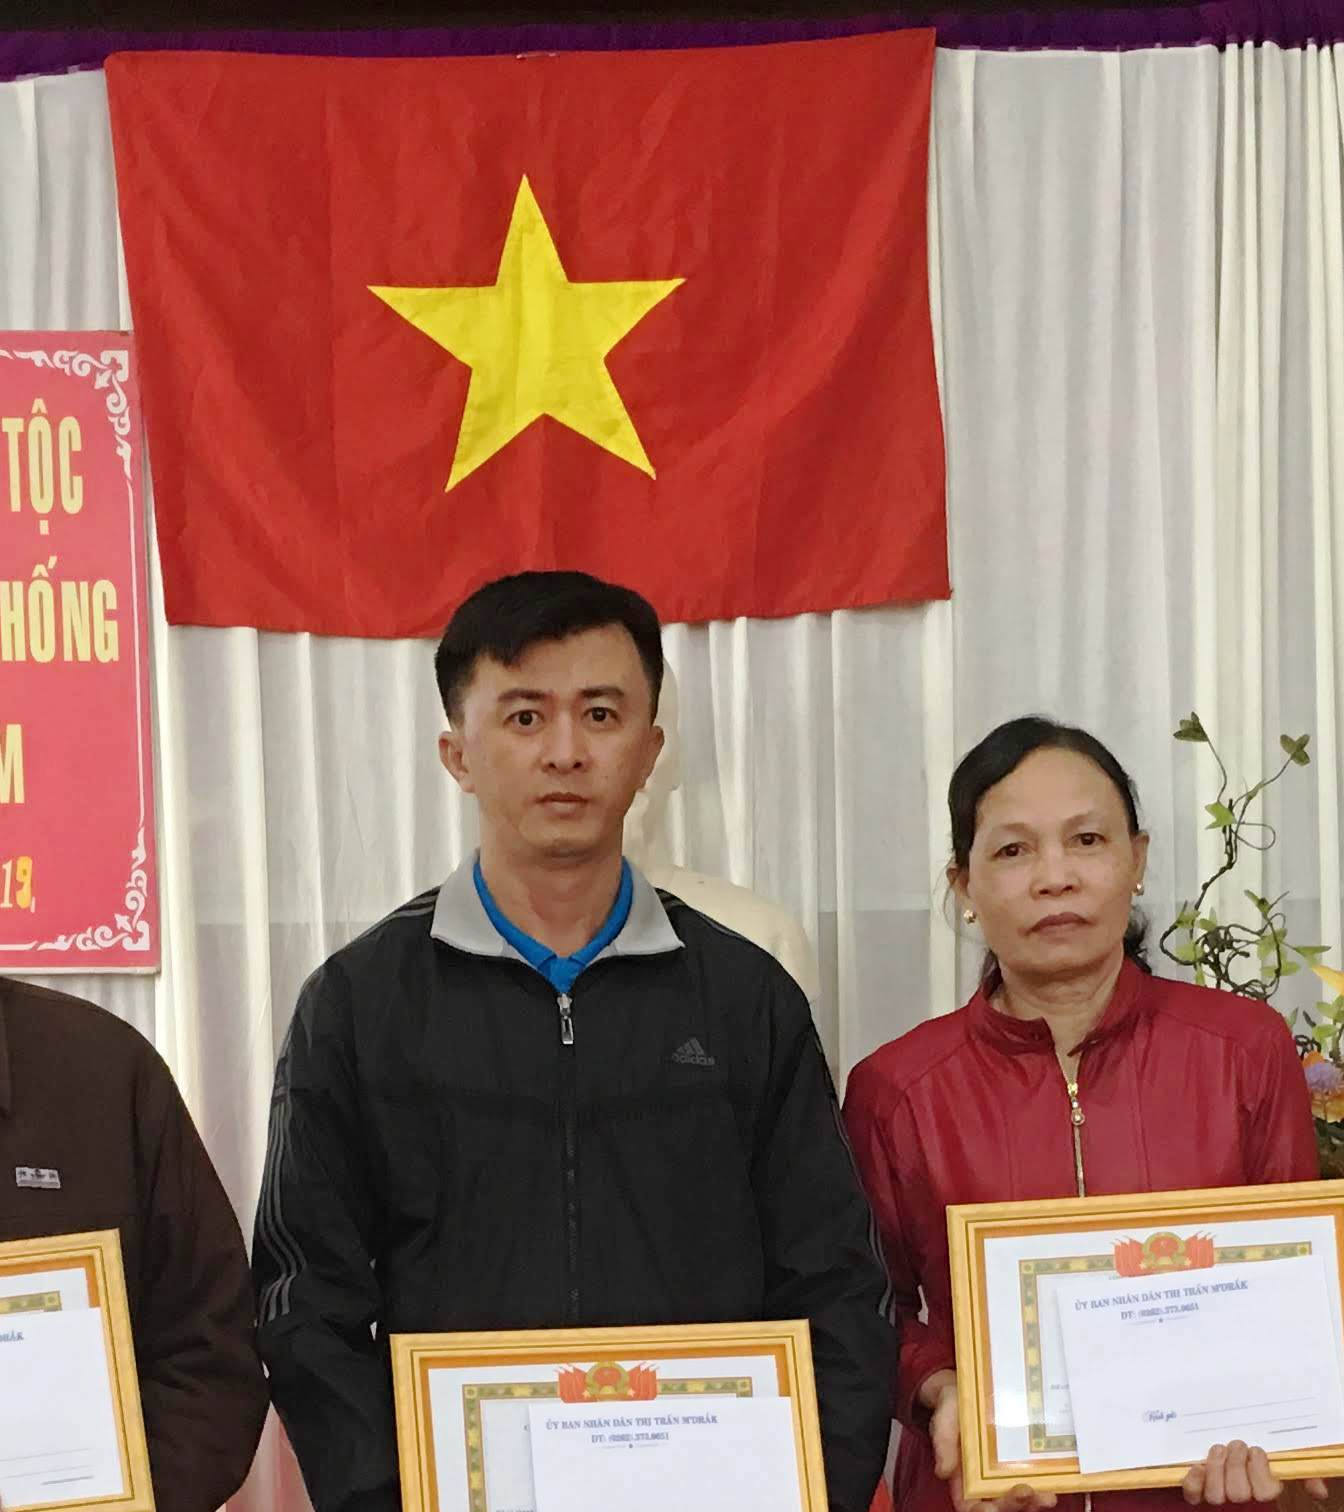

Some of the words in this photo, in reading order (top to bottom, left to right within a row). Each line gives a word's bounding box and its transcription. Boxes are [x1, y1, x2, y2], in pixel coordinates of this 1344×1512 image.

[1, 398, 84, 535] TỘC
[1091, 1298, 1110, 1309] BAN
[562, 1420, 580, 1430] BAN
